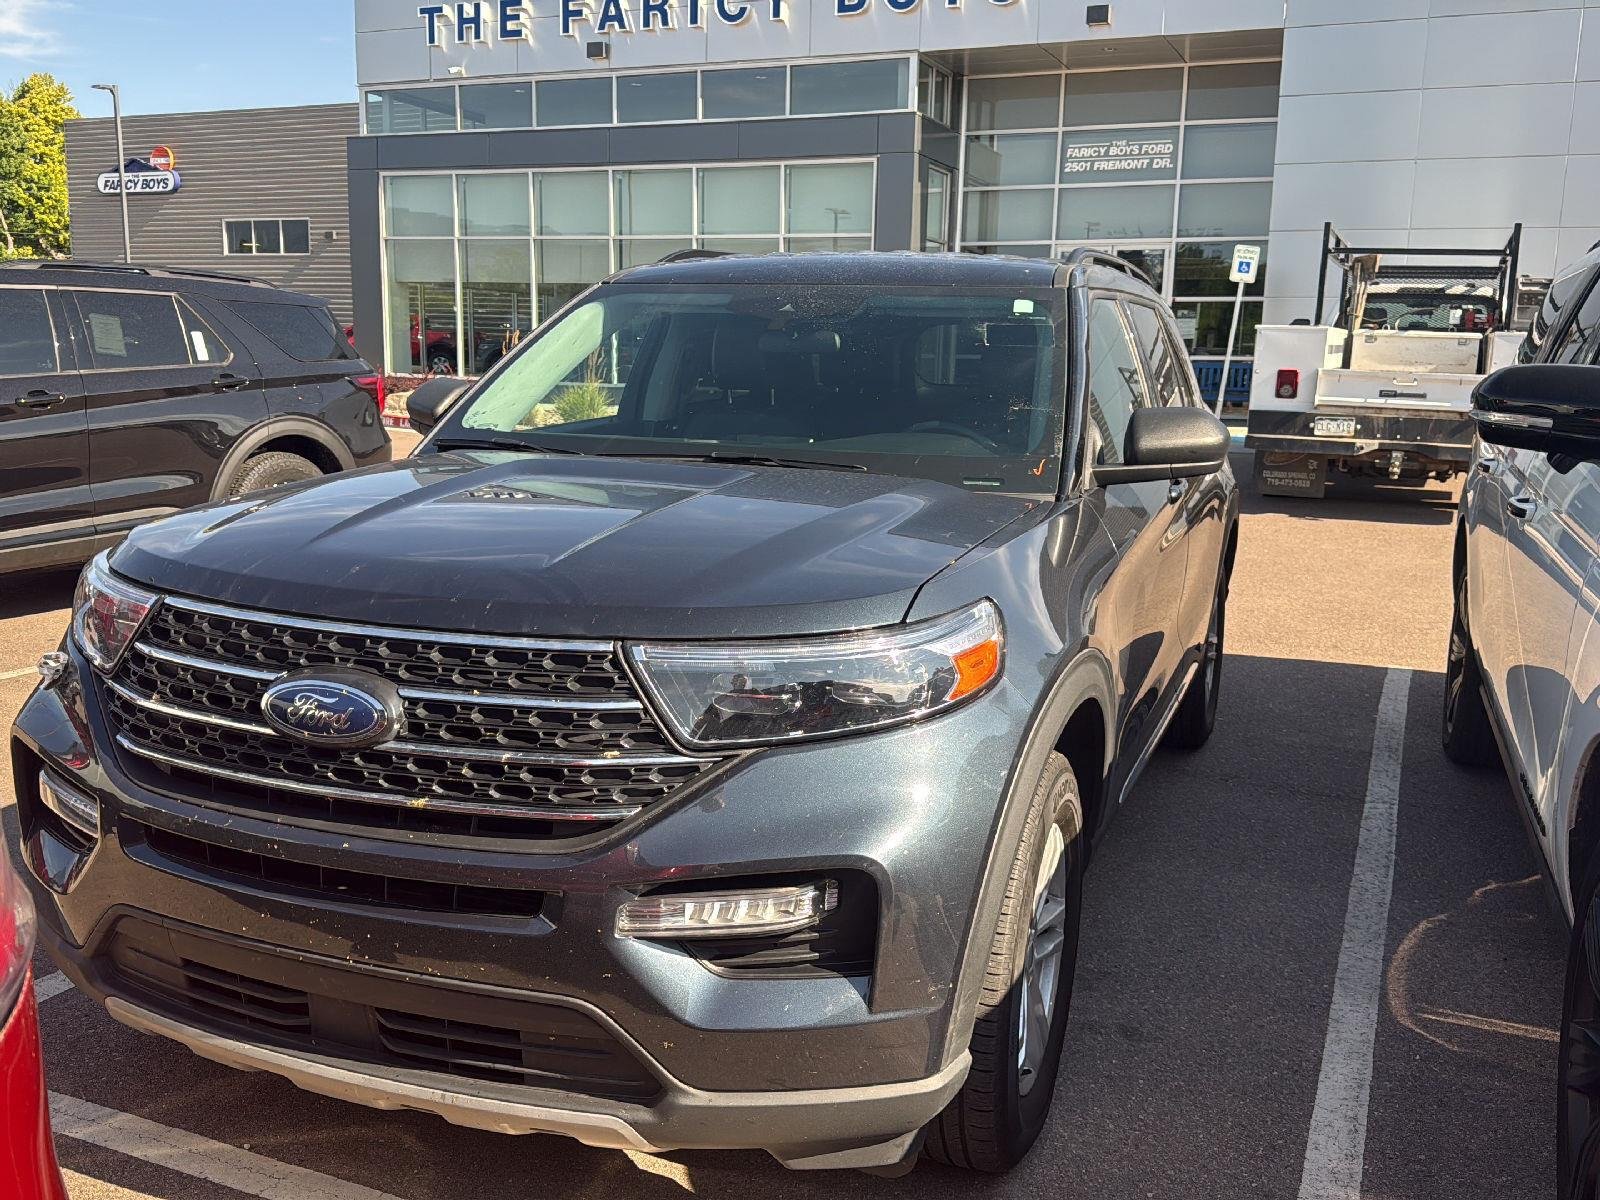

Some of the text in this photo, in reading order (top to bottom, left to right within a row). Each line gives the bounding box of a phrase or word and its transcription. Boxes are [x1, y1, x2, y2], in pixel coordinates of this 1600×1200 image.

[418, 0, 524, 47] THE
[1066, 143, 1174, 157] FARICY BOYS FORD
[1064, 158, 1174, 172] 2501 FREMONT DR.
[103, 178, 169, 190] FARCY BOYS
[287, 692, 354, 730] Ford
